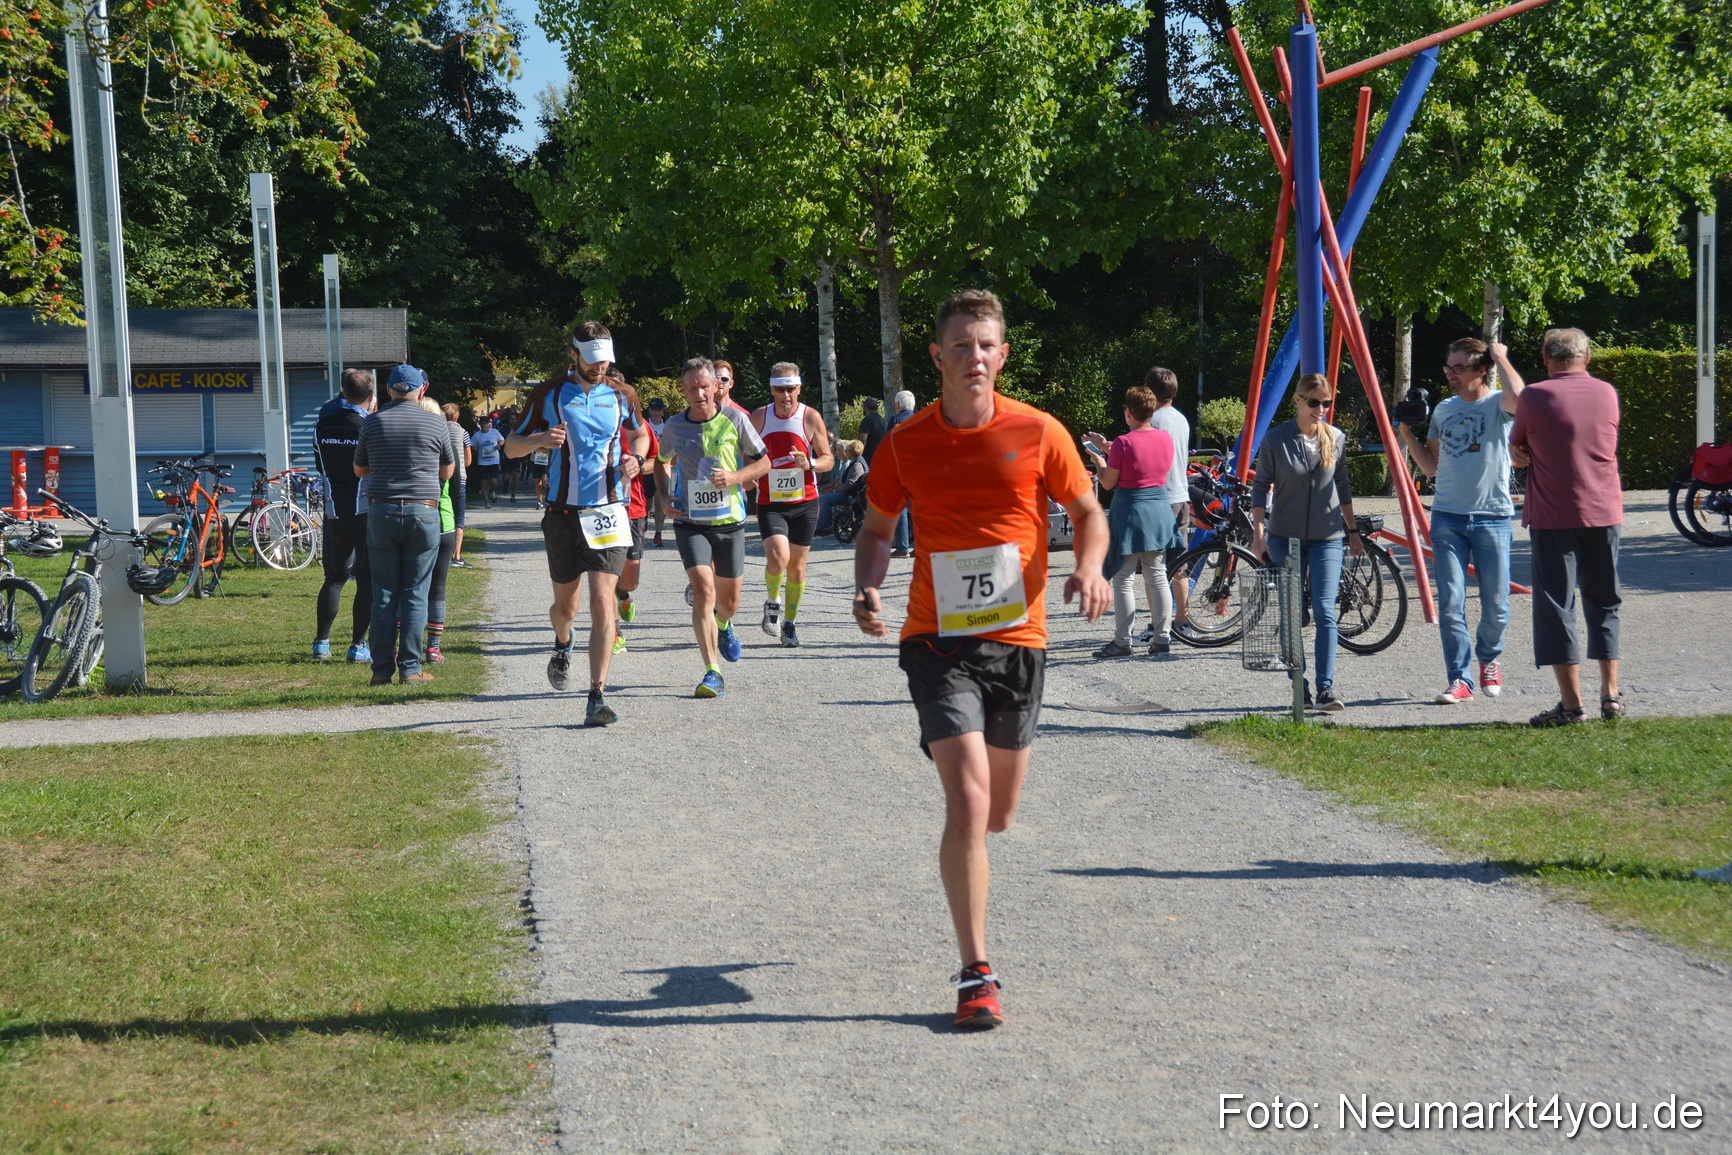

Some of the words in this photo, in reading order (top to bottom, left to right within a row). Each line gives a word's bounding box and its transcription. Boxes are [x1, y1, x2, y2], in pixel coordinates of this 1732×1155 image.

[134, 373, 182, 388] CAFE
[194, 373, 248, 388] KIOSK
[777, 477, 796, 488] 270
[694, 490, 724, 505] 3081
[593, 514, 618, 531] 332
[962, 572, 994, 600] 75
[966, 612, 1000, 627] Simon
